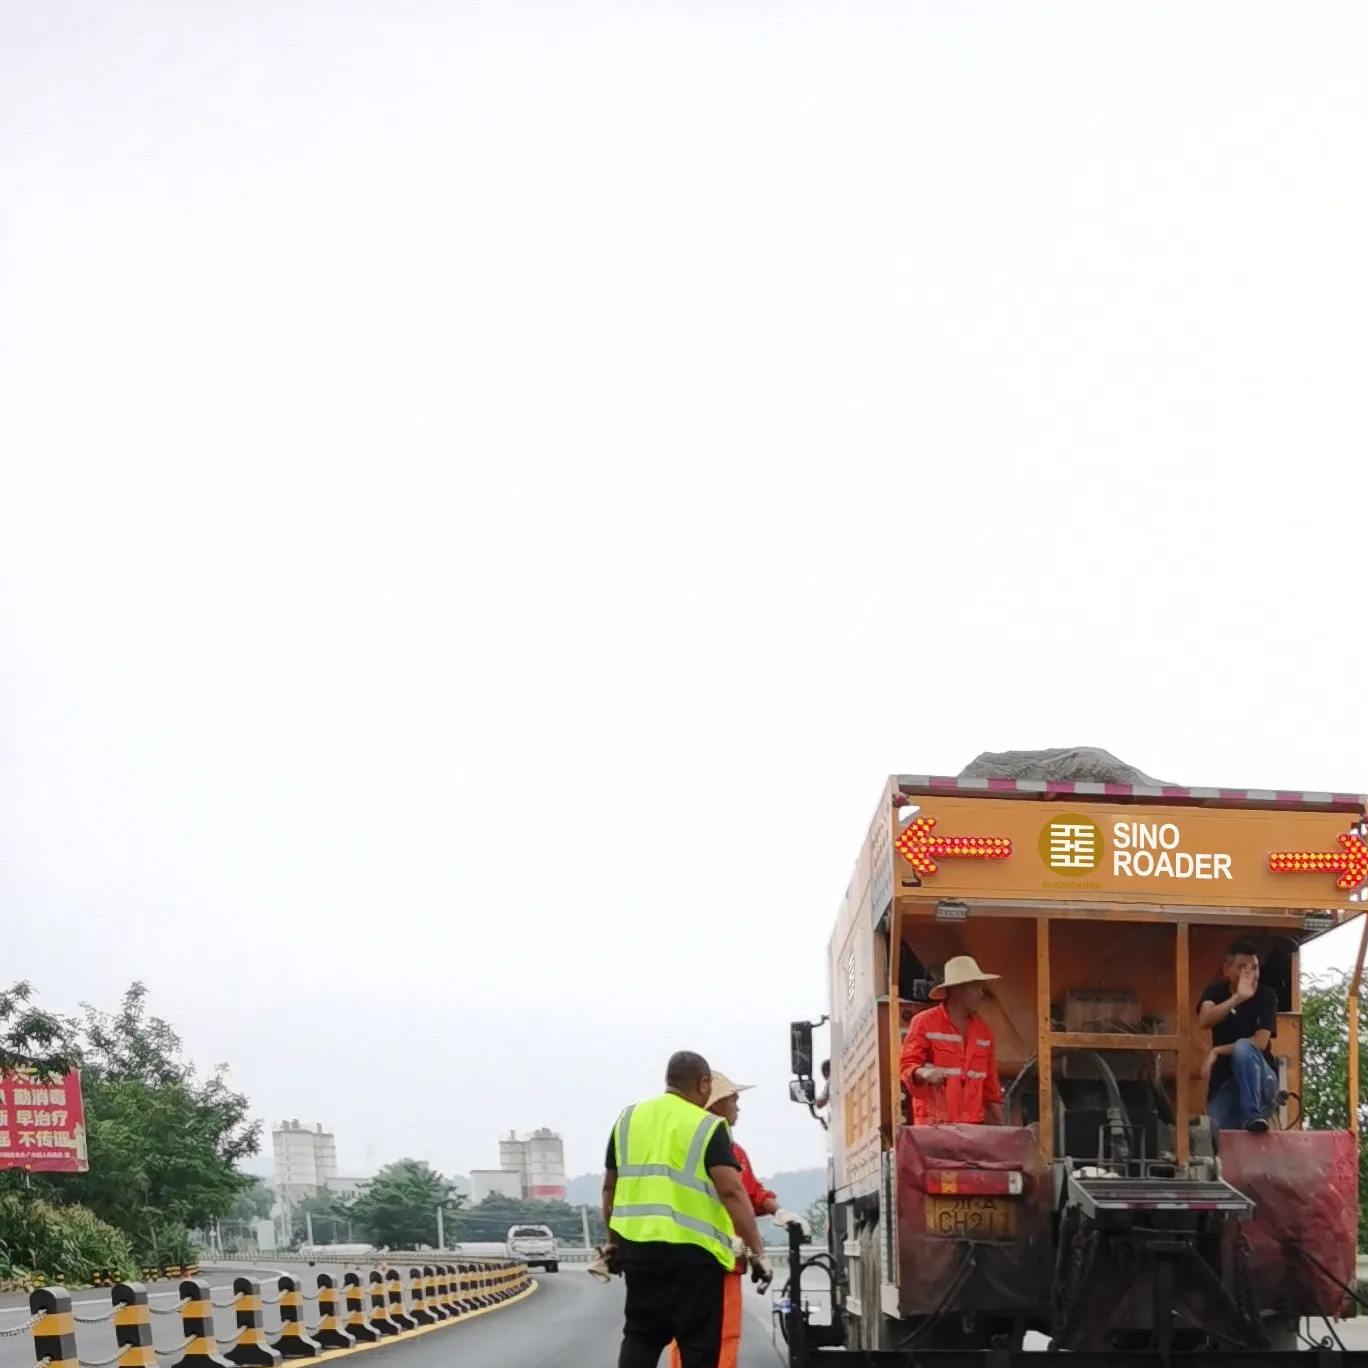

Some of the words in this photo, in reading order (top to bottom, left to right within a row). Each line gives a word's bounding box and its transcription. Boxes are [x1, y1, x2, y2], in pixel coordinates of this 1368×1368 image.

[1112, 821, 1180, 850] SINO
[1113, 850, 1234, 880] ROADER
[16, 1109, 69, 1127] 早治疗
